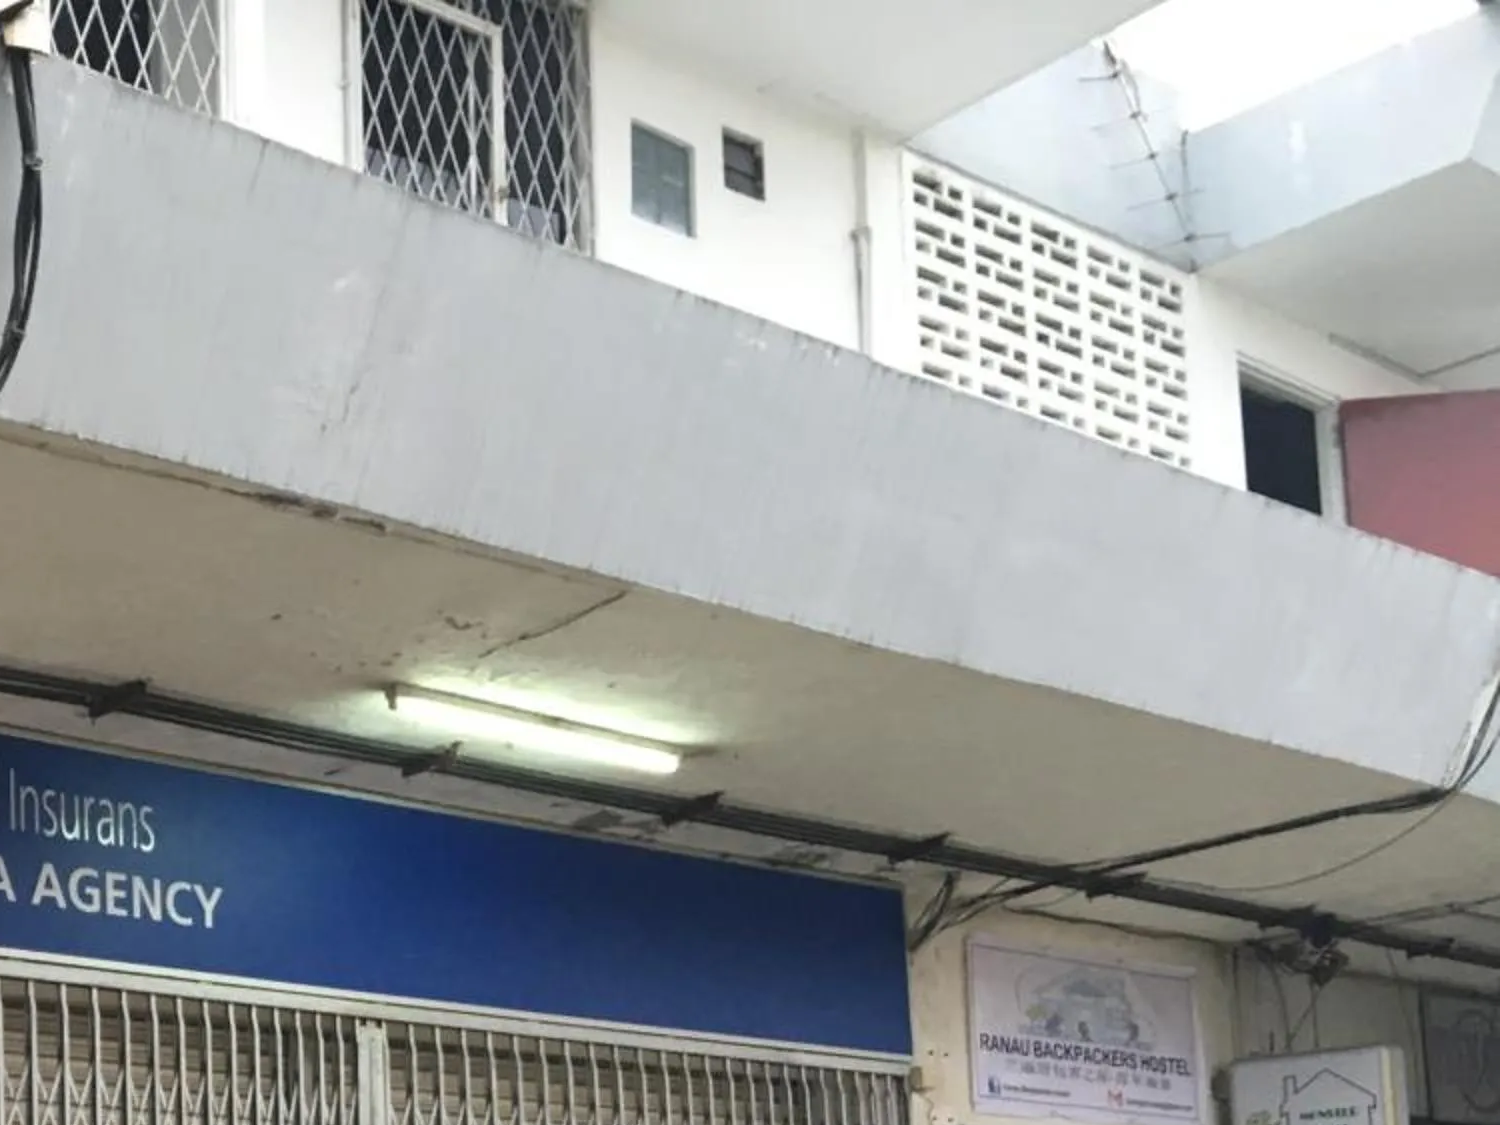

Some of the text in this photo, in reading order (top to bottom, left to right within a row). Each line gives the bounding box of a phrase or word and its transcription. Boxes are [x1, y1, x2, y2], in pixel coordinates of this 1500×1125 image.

[9, 767, 156, 853] Insurans
[31, 862, 223, 929] AGENCY
[979, 1032, 1031, 1057] RANAU
[1033, 1040, 1138, 1070] BACKPACKERS
[1139, 1054, 1192, 1076] HOSTEL
